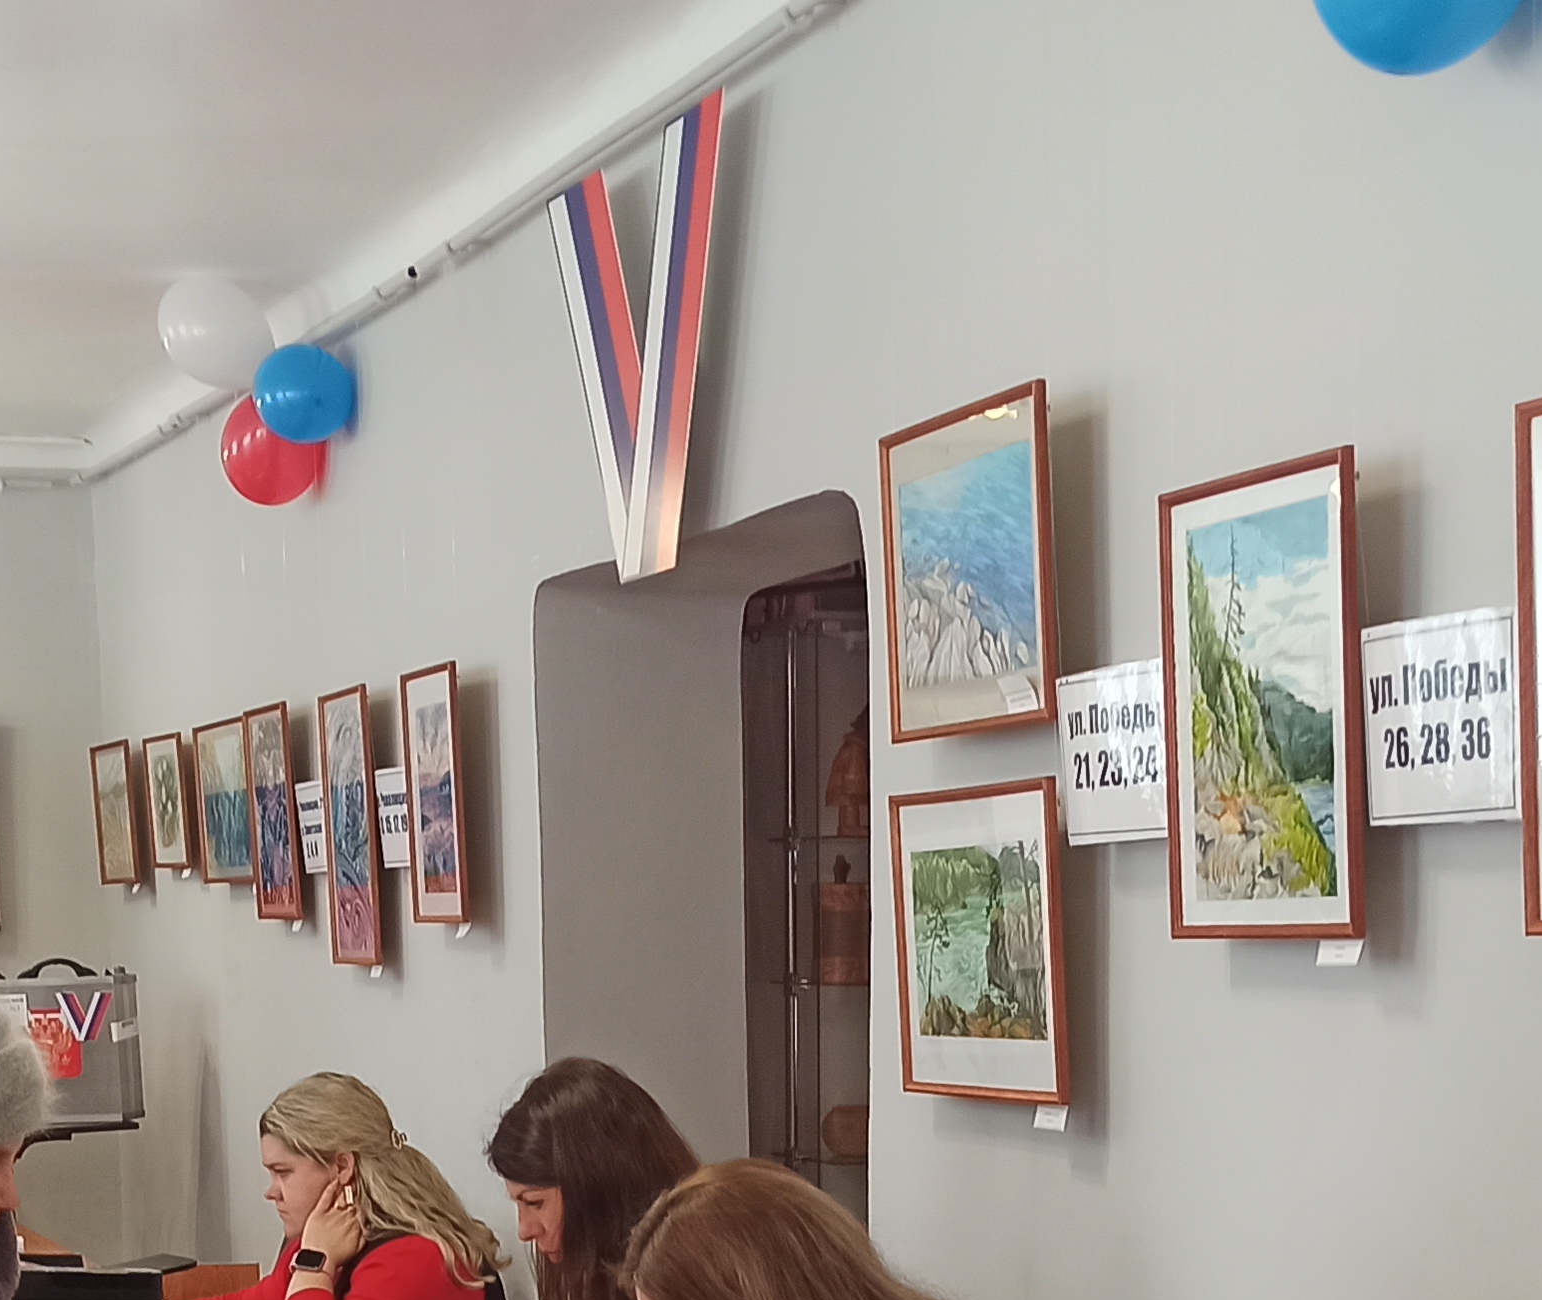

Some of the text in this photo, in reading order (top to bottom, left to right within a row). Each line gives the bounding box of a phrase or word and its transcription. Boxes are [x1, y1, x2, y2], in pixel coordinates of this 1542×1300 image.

[1369, 657, 1507, 715] ул. Победы
[1067, 710, 1087, 740] ул.
[1384, 716, 1491, 771] 26, 28, 36
[1074, 751, 1095, 792] 21,
[1097, 749, 1127, 790] 23,
